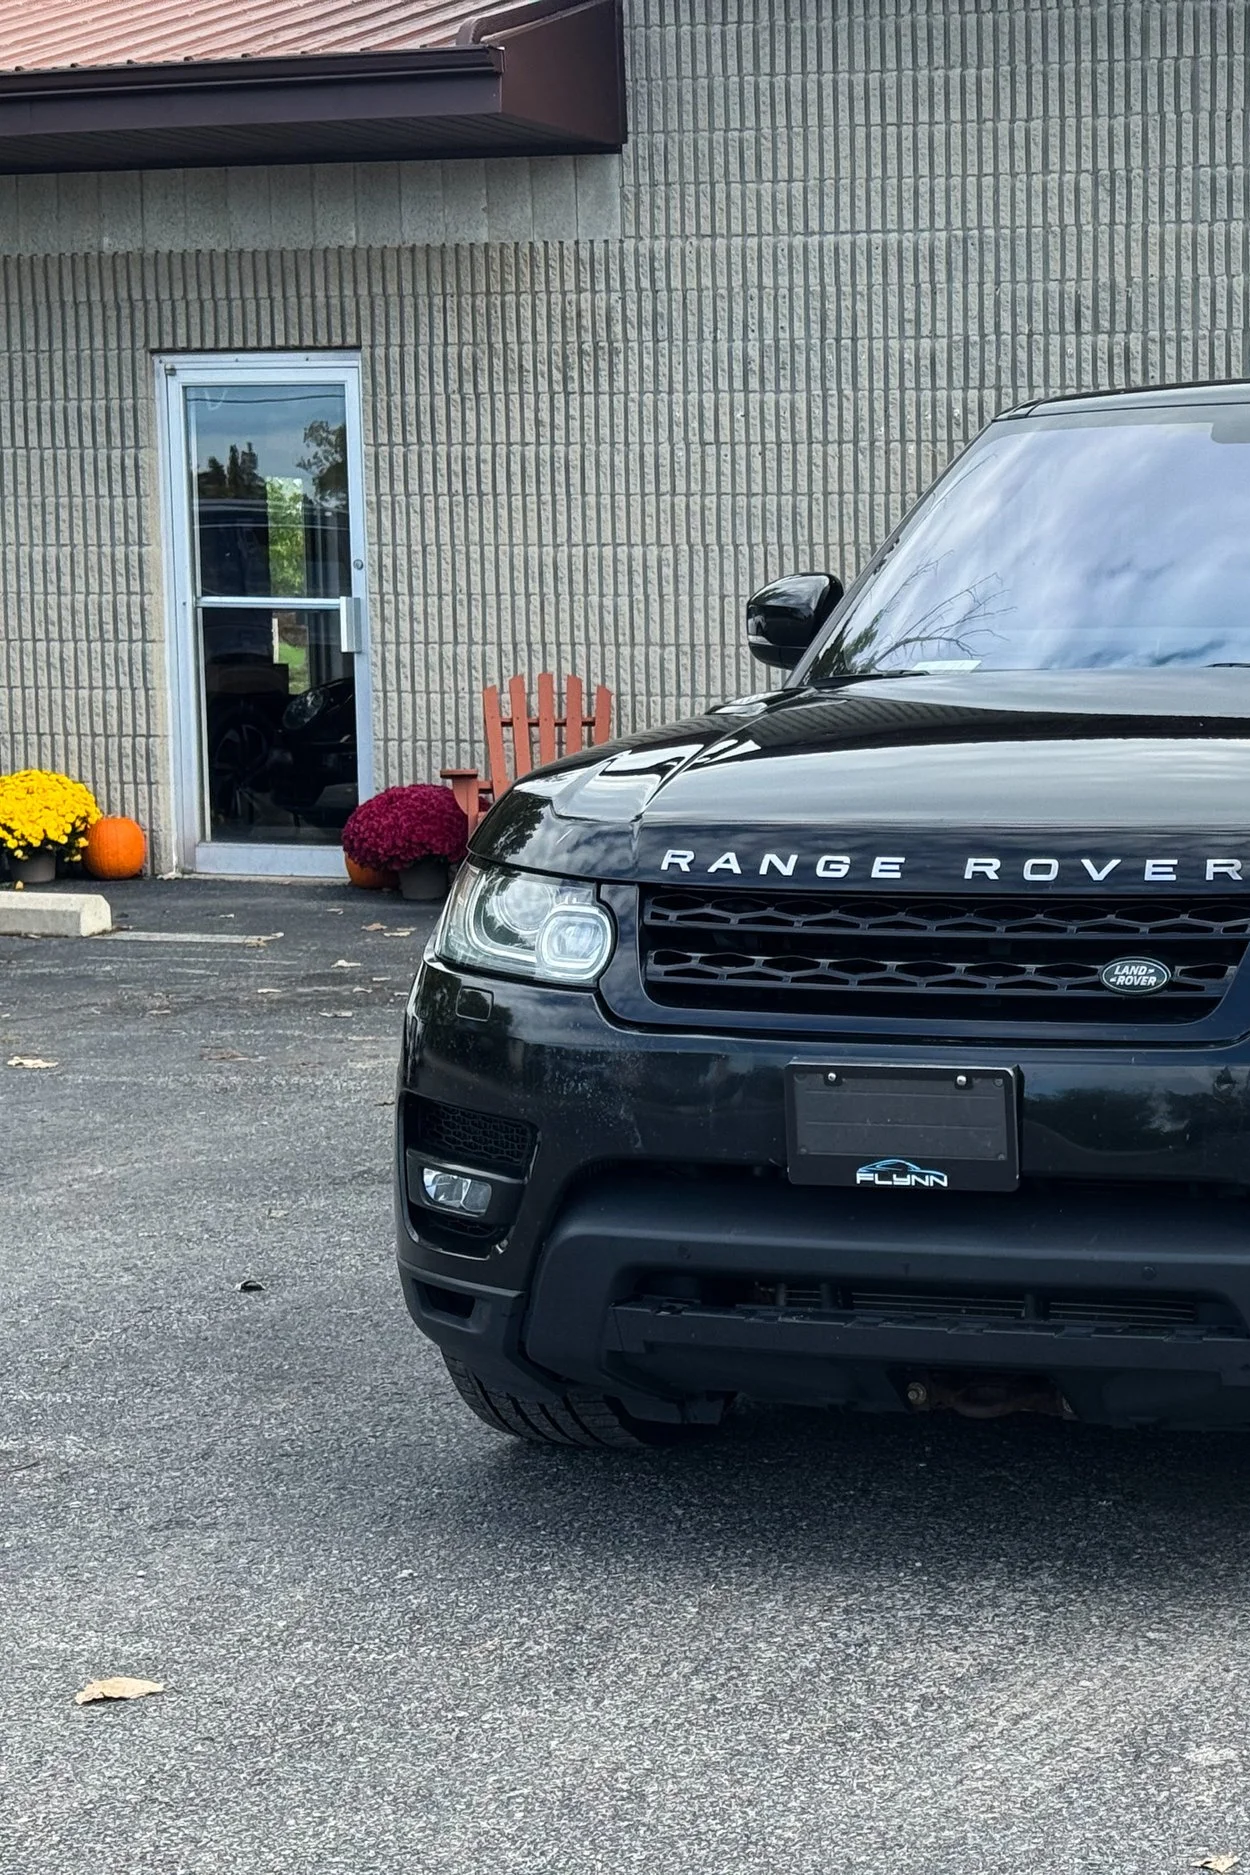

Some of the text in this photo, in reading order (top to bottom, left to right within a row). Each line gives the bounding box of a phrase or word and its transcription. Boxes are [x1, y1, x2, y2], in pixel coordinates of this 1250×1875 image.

[660, 849, 1243, 882] RANGE ROVER
[1114, 966, 1148, 975] LAND
[1116, 976, 1157, 986] ROVER
[856, 1172, 948, 1187] FLYNN
